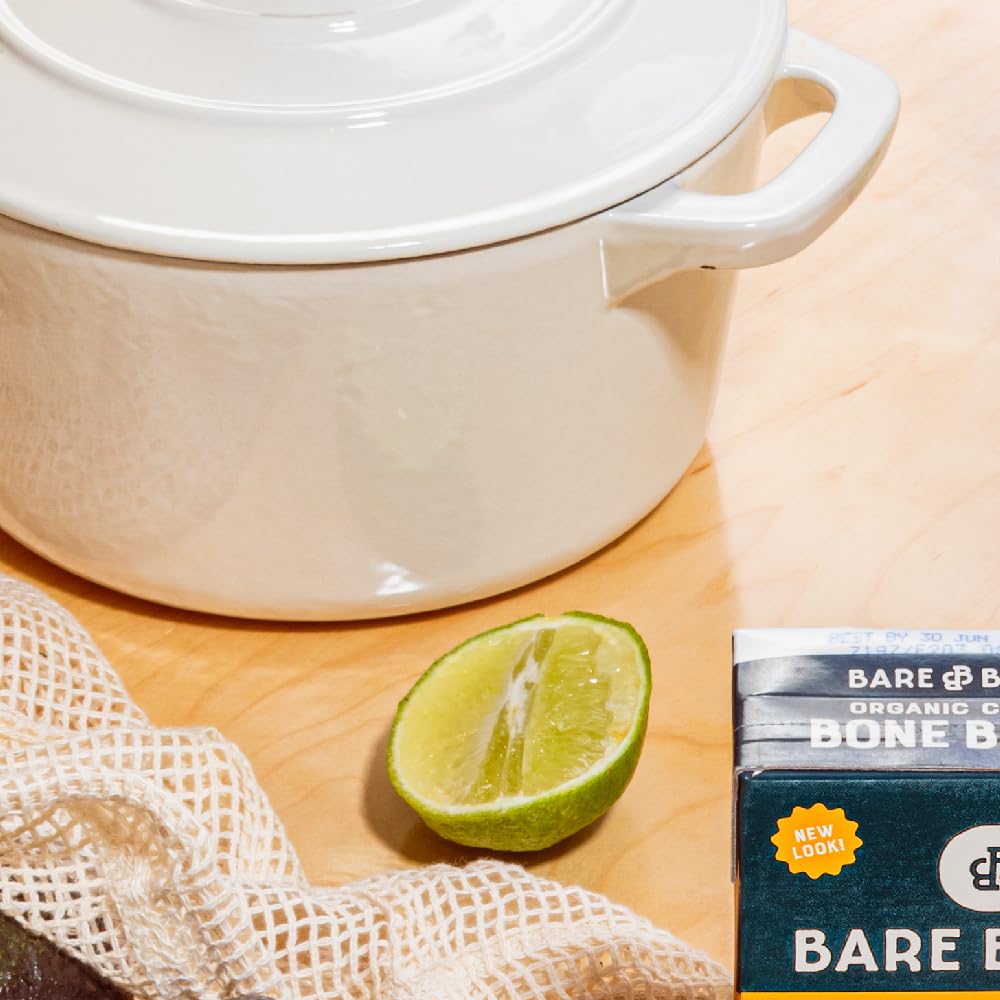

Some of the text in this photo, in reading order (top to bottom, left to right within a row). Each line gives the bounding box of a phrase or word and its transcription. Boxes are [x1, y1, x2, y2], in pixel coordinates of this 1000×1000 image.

[885, 631, 909, 643] BY
[919, 632, 943, 642] 30
[954, 633, 989, 643] JUN
[848, 668, 934, 689] BARE
[850, 702, 969, 715] ORGANIC
[809, 718, 950, 749] BONE
[793, 823, 834, 843] NEW
[791, 838, 846, 860] LOOK!
[793, 928, 962, 973] BARE
